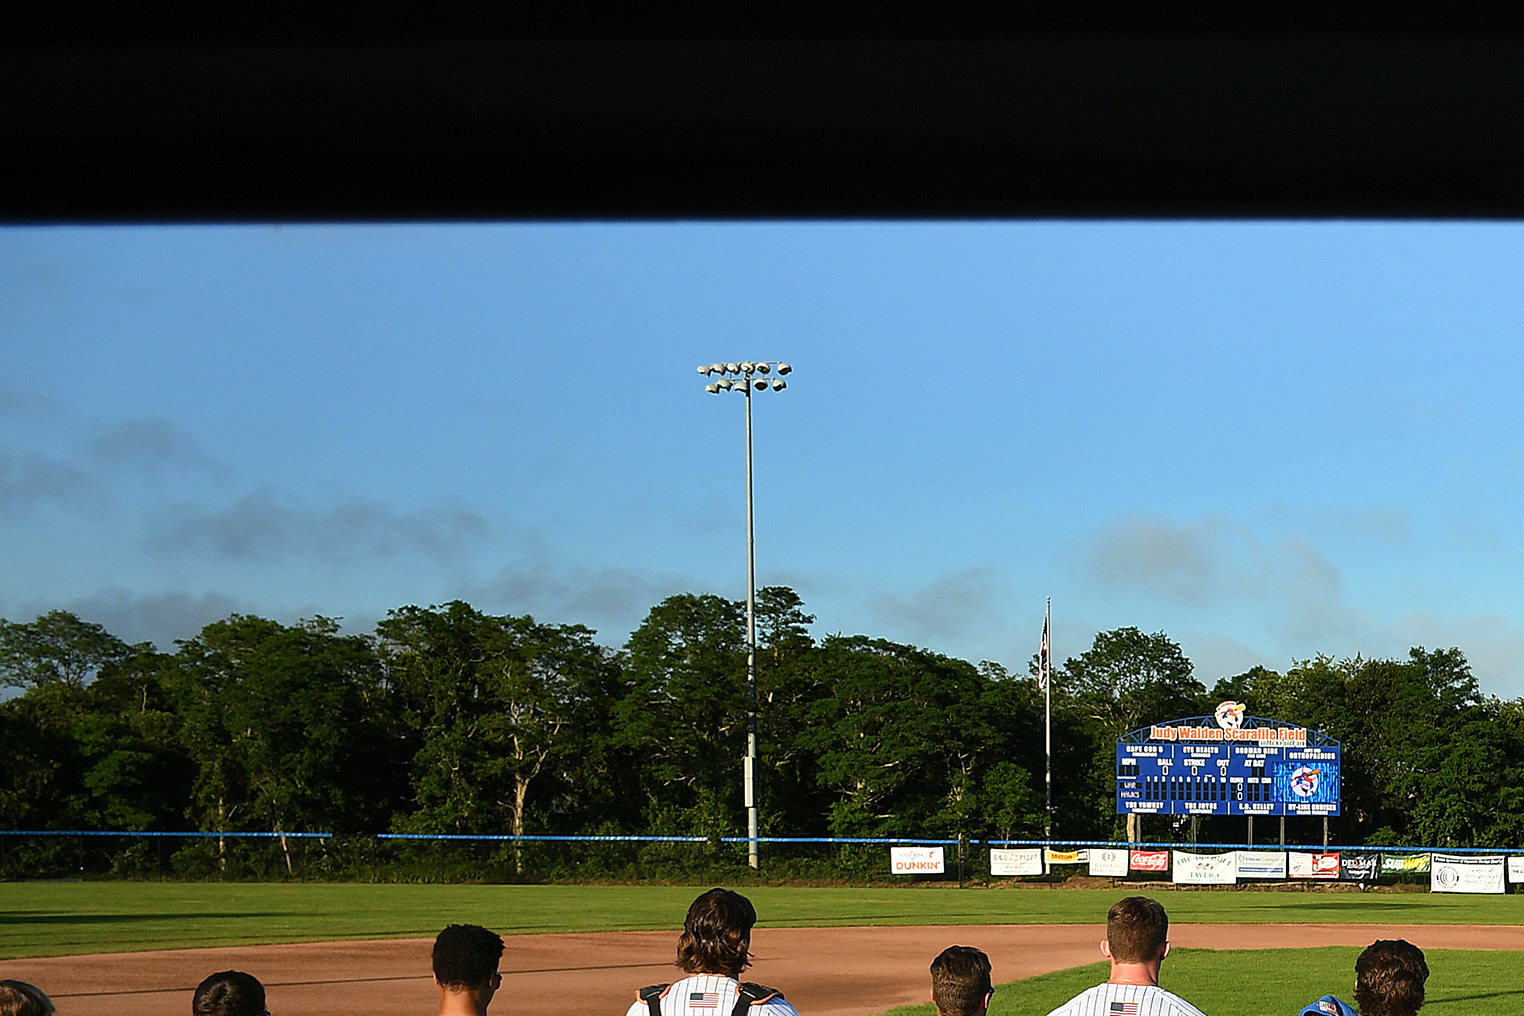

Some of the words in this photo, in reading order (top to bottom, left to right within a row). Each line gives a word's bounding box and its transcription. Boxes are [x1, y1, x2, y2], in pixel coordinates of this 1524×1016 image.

[1151, 727, 1177, 740] Judy
[1179, 727, 1222, 740] Walden
[1225, 728, 1276, 740] Scarafile
[1279, 728, 1305, 740] Field
[1217, 759, 1230, 767] OUT
[1162, 766, 1169, 775] 0
[1191, 766, 1198, 775] 0
[1220, 766, 1227, 776] 0
[1237, 783, 1243, 791] 0
[1237, 792, 1243, 800] 0
[896, 861, 941, 871] DUNKIN'
[1342, 859, 1356, 868] DEL
[1382, 857, 1428, 870] SUBWAY
